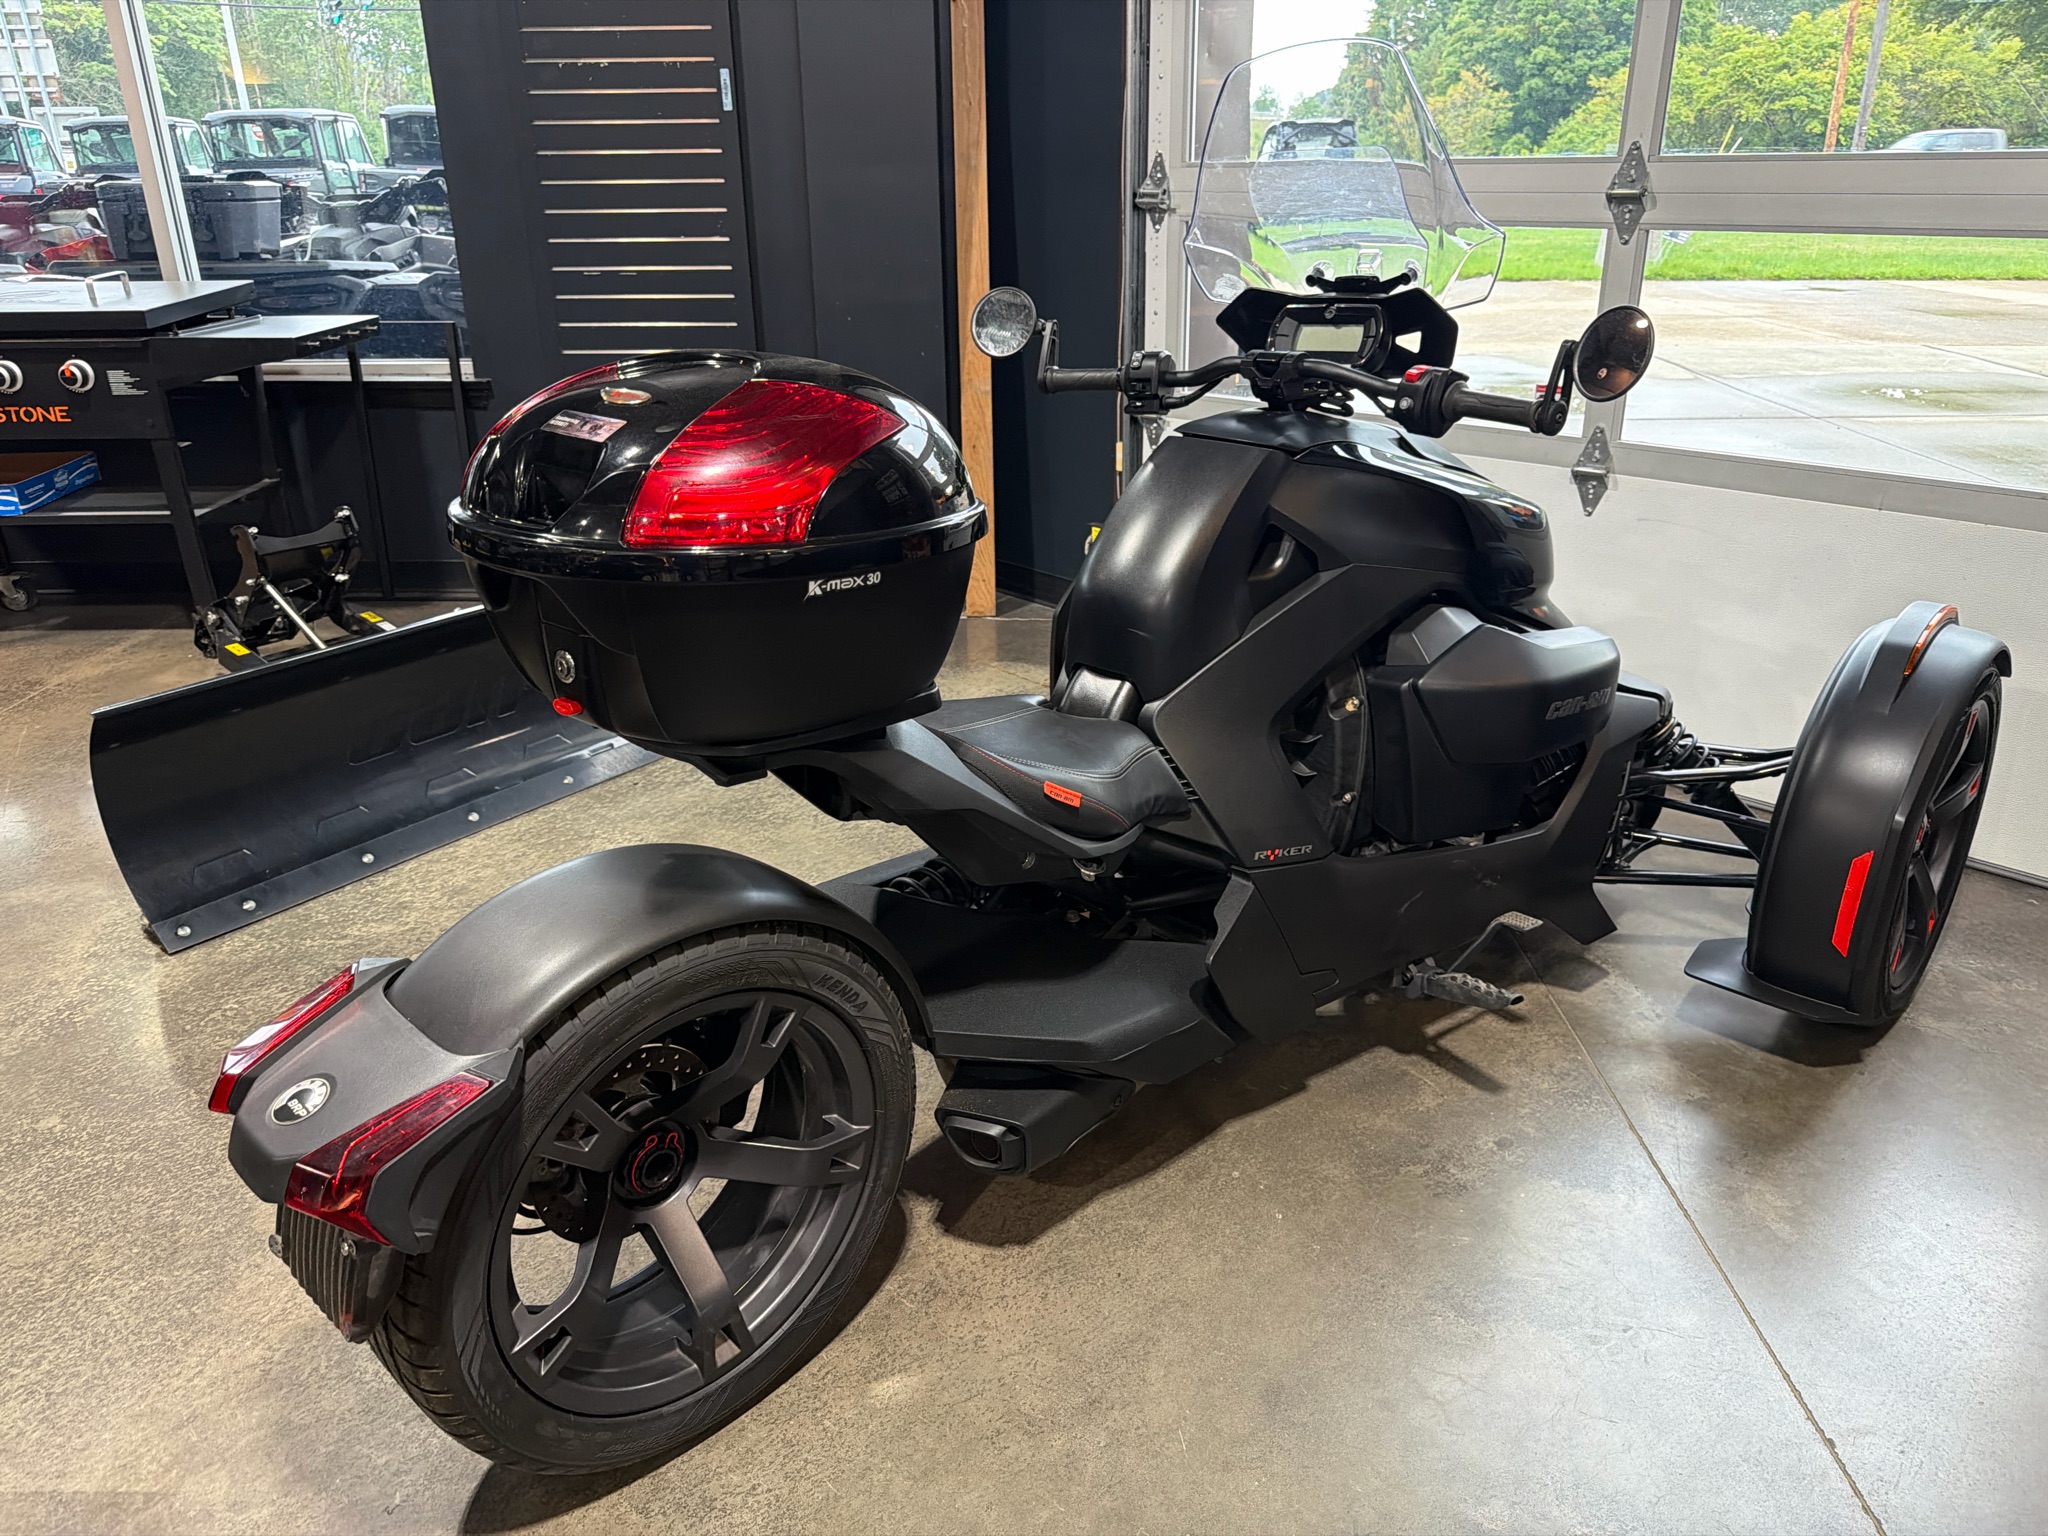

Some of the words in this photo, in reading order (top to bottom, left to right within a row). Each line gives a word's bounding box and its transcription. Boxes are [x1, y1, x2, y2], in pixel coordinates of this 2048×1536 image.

[866, 571, 881, 585] 30
[1253, 844, 1313, 861] RYKER
[814, 973, 869, 1013] KENDA
[287, 1098, 308, 1117] BRP
